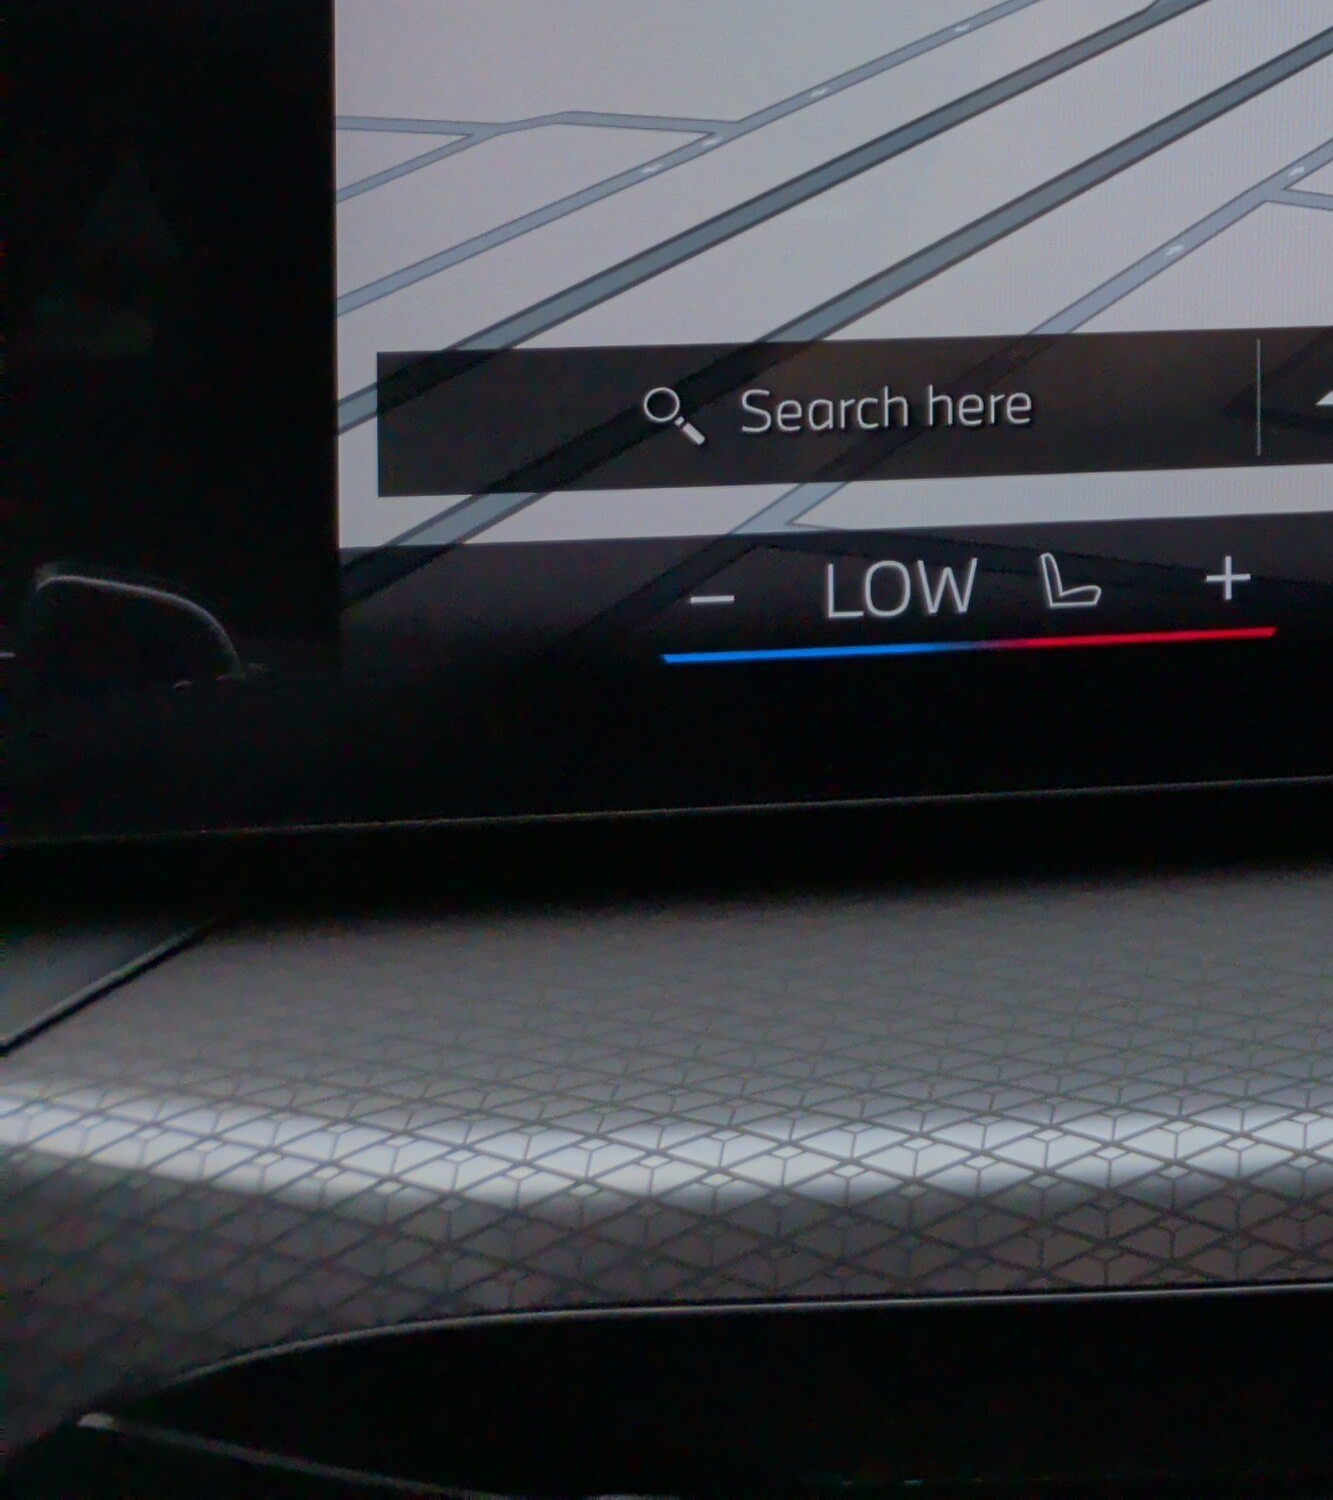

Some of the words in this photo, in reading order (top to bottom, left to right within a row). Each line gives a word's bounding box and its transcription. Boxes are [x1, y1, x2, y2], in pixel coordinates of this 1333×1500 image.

[740, 386, 910, 433] Search
[928, 385, 1034, 428] here
[825, 558, 978, 619] LOW
